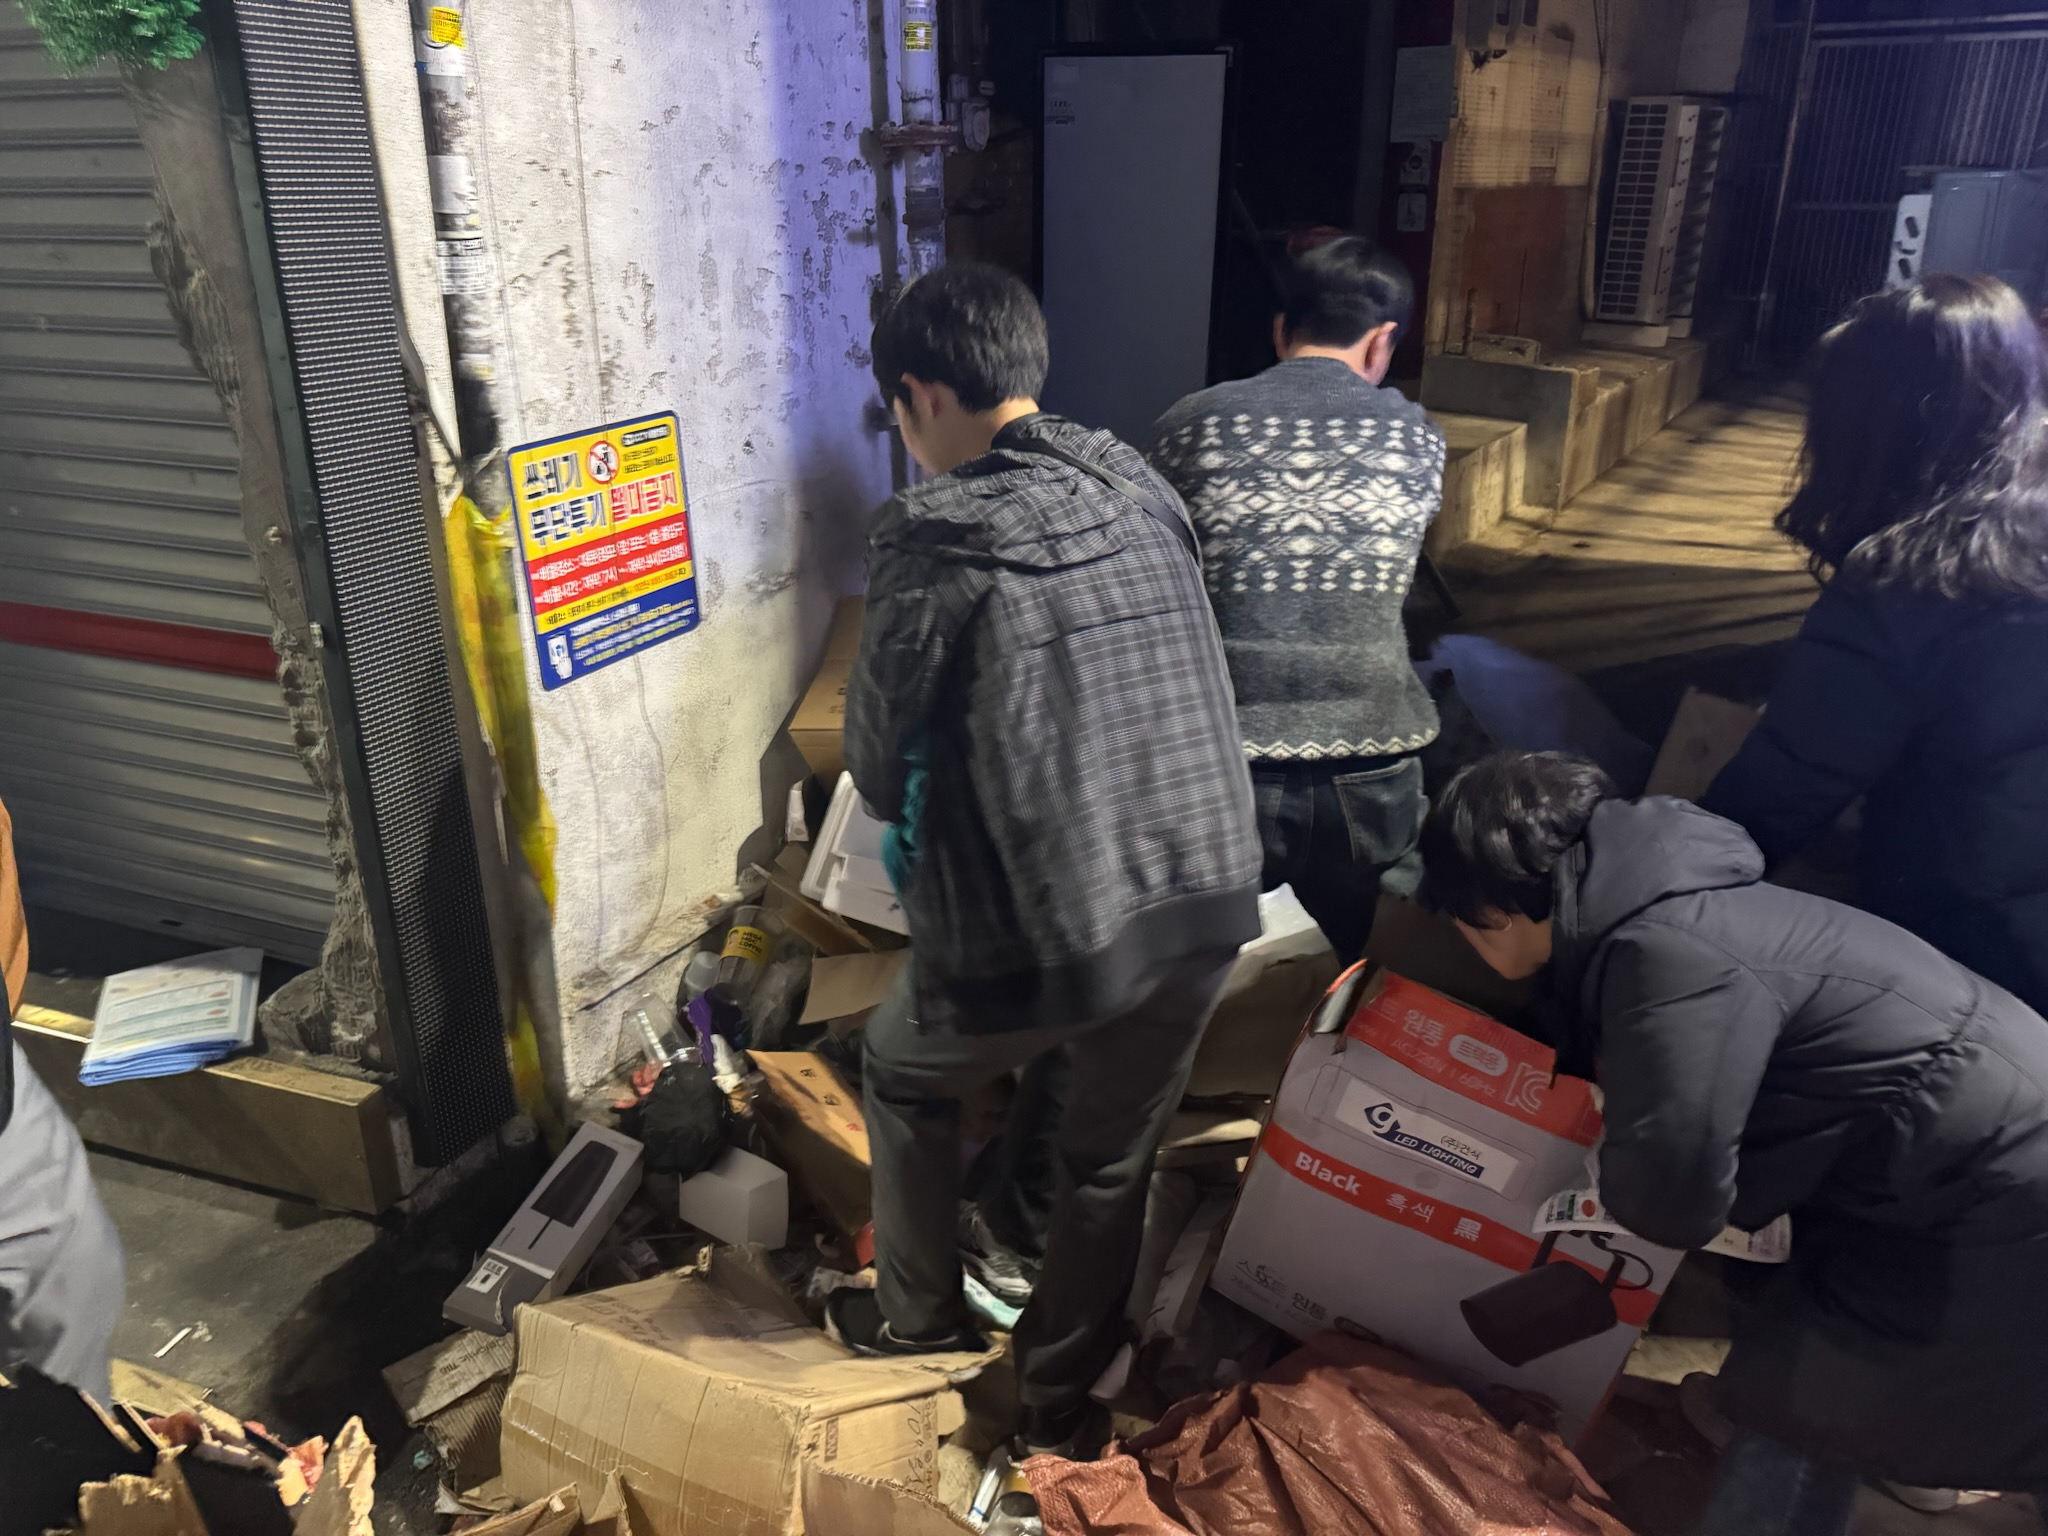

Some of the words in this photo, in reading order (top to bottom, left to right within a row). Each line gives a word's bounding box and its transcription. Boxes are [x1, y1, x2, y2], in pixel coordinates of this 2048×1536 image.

[523, 452, 582, 500] 쓰레기
[530, 492, 606, 546] 무단투기
[610, 472, 678, 523] 절대금지
[1402, 1009, 1446, 1047] 원통
[1295, 1152, 1363, 1196] Black
[1394, 1134, 1419, 1149] LED
[1421, 1143, 1479, 1175] LIGHTING
